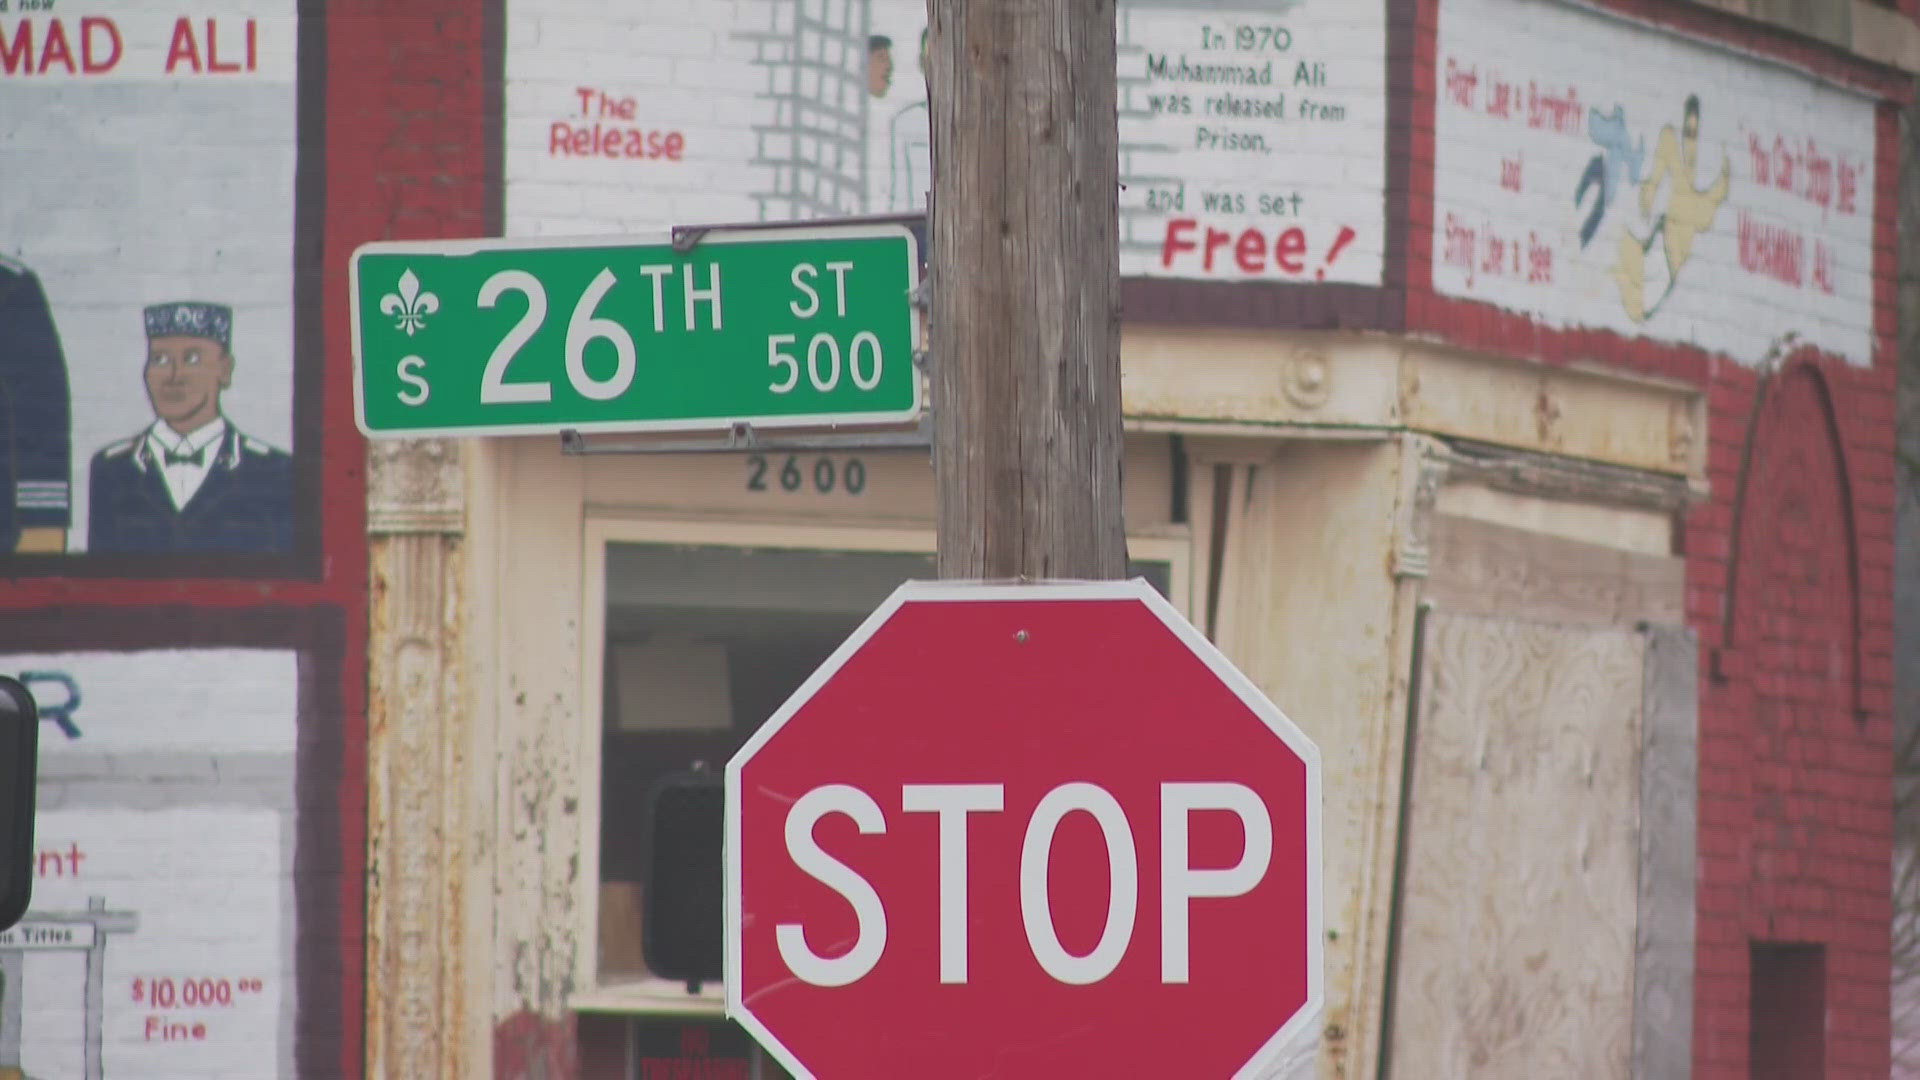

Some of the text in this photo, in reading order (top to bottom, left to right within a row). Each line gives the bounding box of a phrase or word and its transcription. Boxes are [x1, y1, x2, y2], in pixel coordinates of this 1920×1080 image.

[165, 17, 257, 74] ALI
[1201, 25, 1292, 51] In 1970
[1146, 53, 1327, 87] Muhammad Ali
[576, 87, 636, 121] The
[1149, 92, 1346, 121] was released from
[550, 122, 684, 161] Release
[1146, 181, 1303, 216] and was set
[1161, 218, 1356, 281] Free!
[789, 260, 853, 319] ST
[397, 354, 430, 406] S
[767, 331, 883, 394] 500
[747, 455, 866, 495] 2600
[776, 782, 1273, 987] STOP
[145, 1016, 206, 1042] Fine
